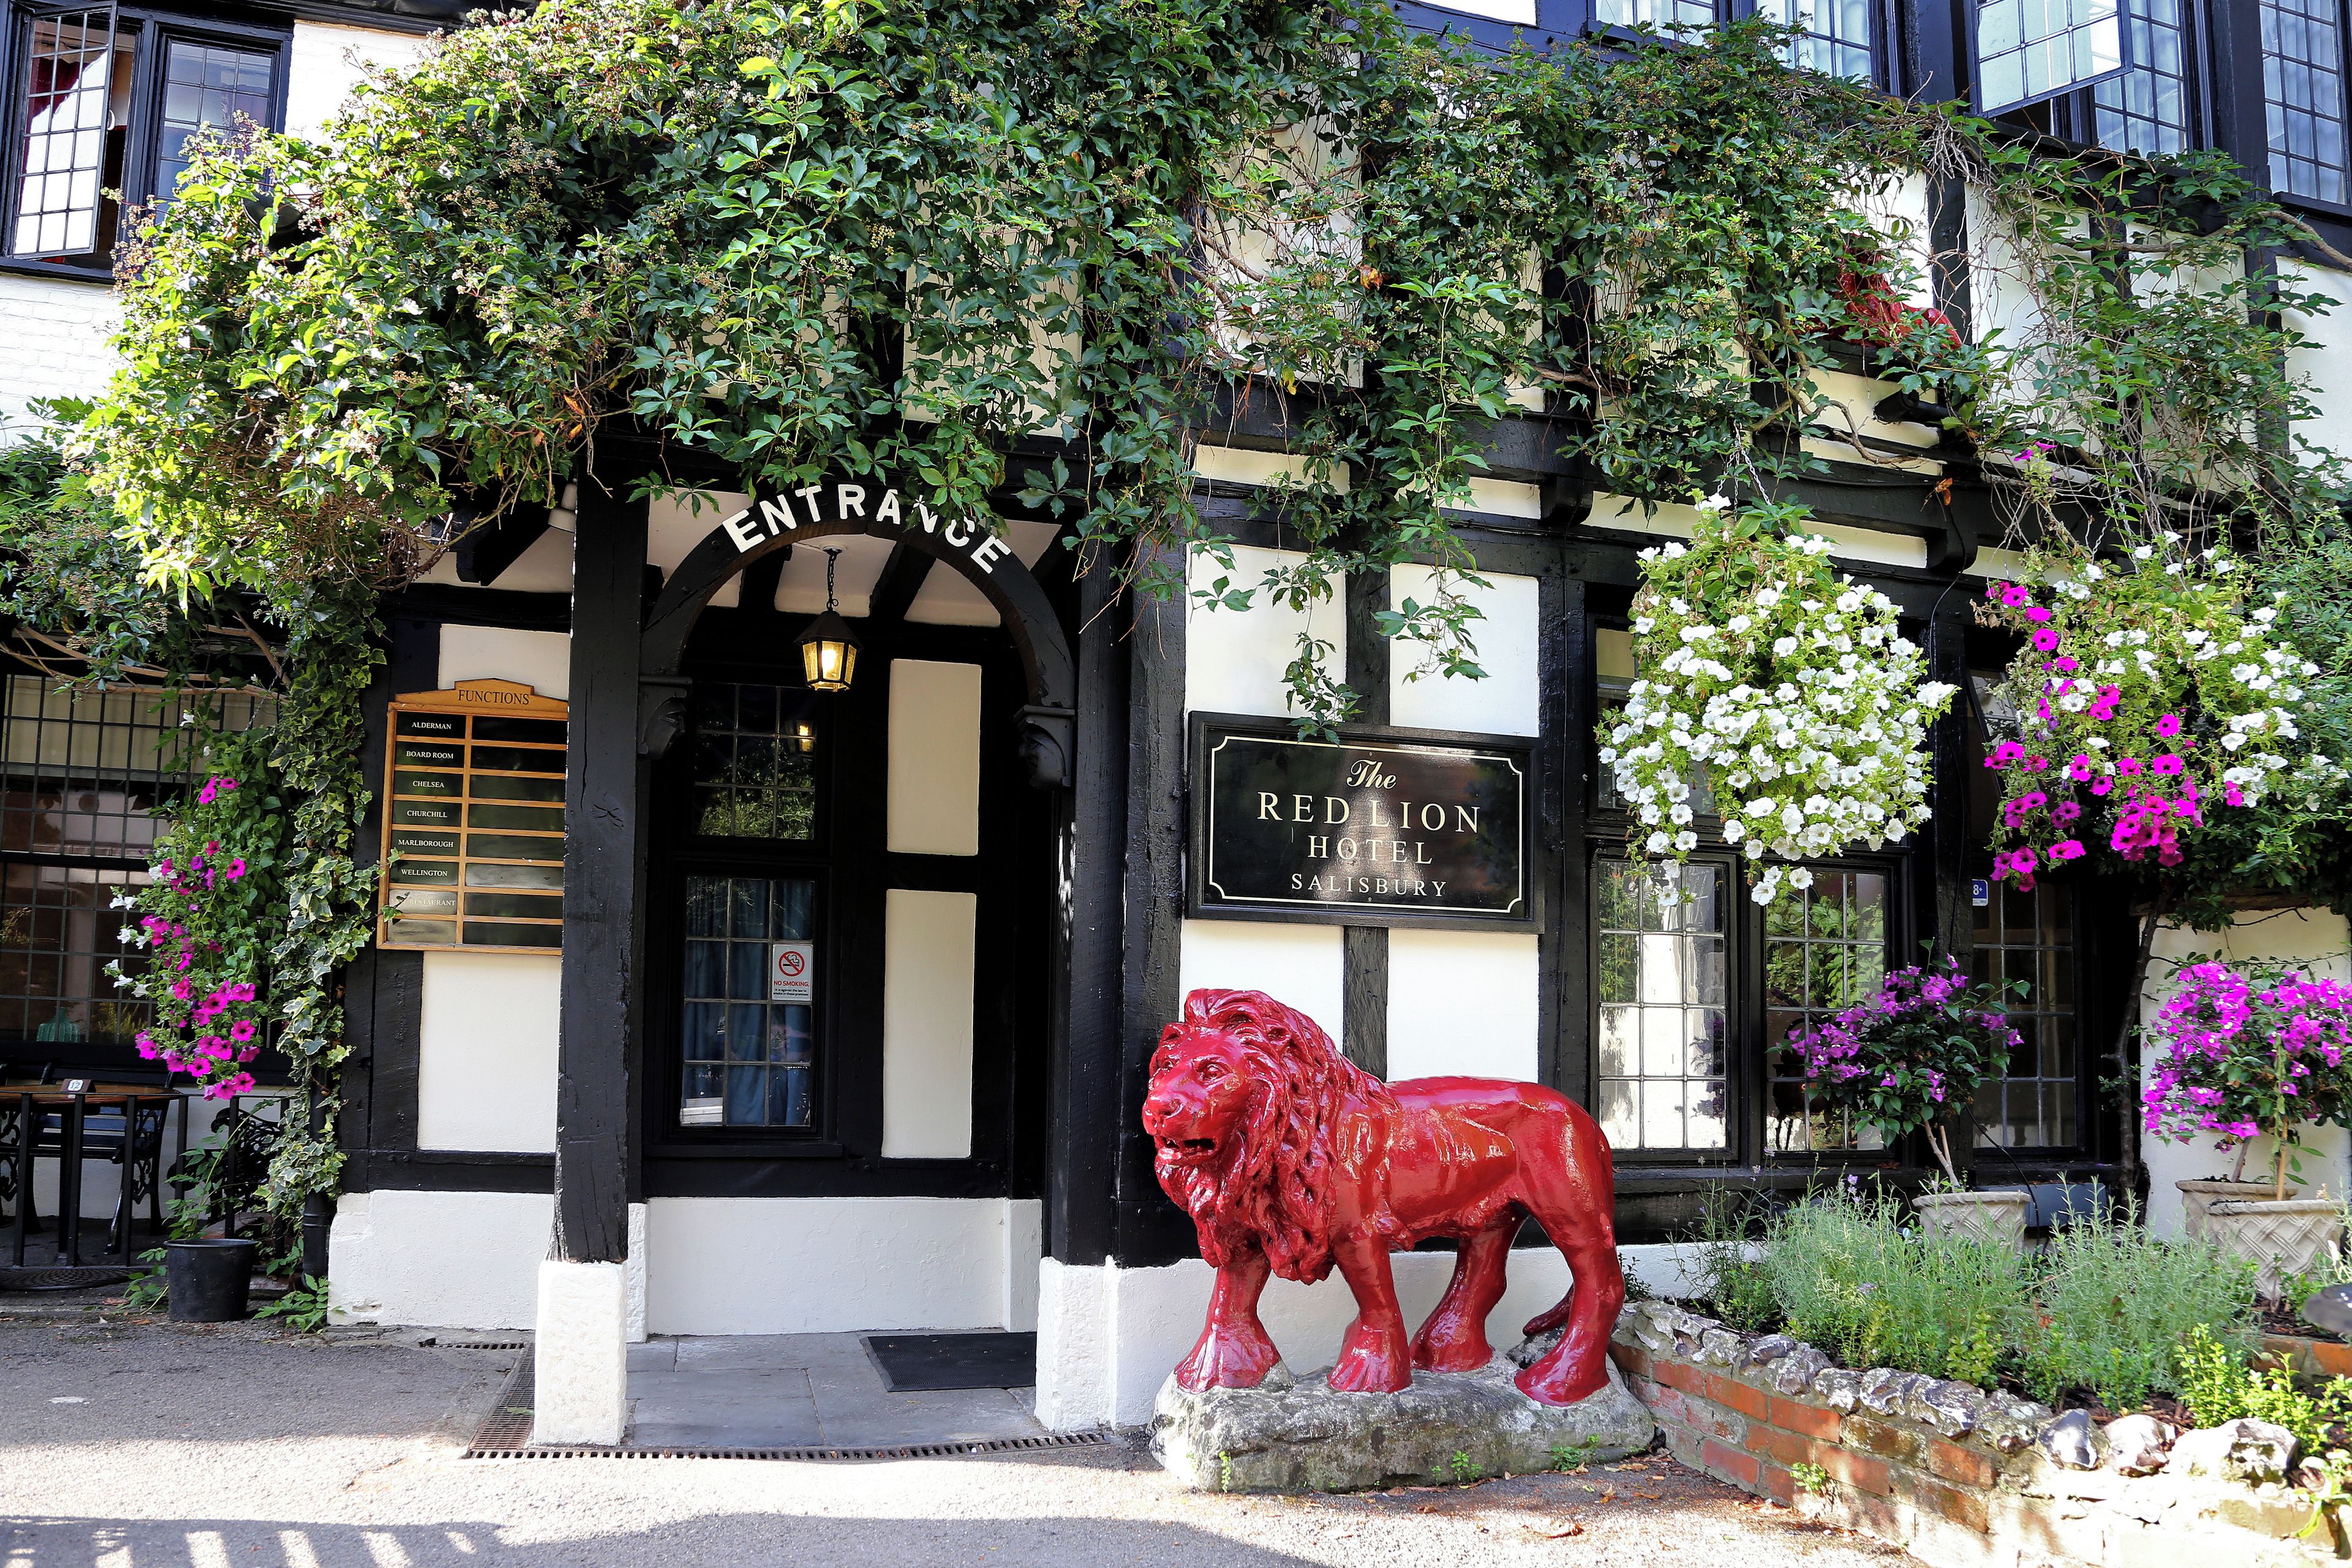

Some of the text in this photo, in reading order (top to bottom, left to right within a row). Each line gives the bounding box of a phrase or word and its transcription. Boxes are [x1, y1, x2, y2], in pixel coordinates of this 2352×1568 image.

[722, 484, 1012, 574] ENTRANCE
[458, 690, 529, 705] FUNCTIONS
[1346, 759, 1397, 790] The
[1257, 791, 1480, 834] RED LION
[398, 839, 454, 848] MARLBOROUGH
[1308, 835, 1433, 865] HOTEL
[1291, 873, 1447, 897] SALISBURY
